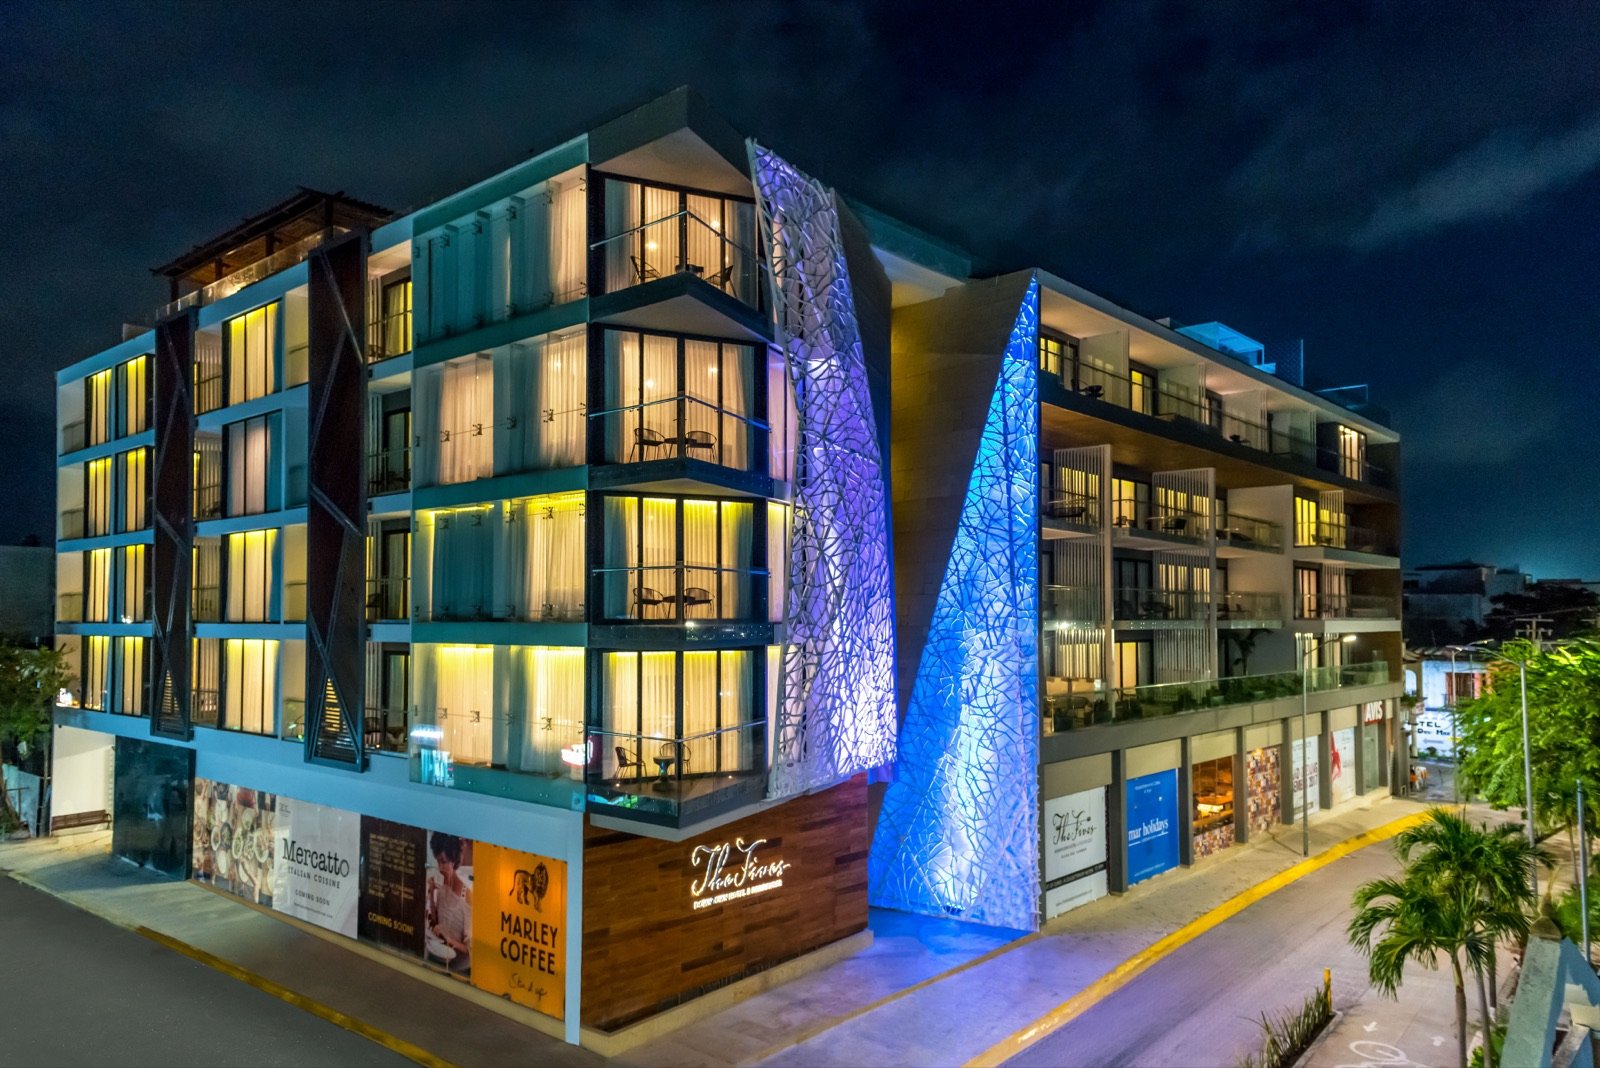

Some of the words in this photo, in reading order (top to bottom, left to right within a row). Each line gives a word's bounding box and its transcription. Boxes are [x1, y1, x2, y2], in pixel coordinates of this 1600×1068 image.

[1365, 701, 1383, 722] AVIS
[1052, 812, 1071, 845] The
[1142, 818, 1169, 837] holidays
[282, 838, 350, 878] Mercatto
[691, 842, 735, 897] The
[734, 837, 791, 887] Fives
[288, 865, 311, 880] ITALIAN
[313, 874, 341, 889] CUISINE
[295, 889, 315, 902] COMING
[315, 894, 331, 906] SOON
[367, 911, 393, 929] COMING
[500, 911, 558, 948] MARLEY
[500, 936, 555, 975] COFFEE
